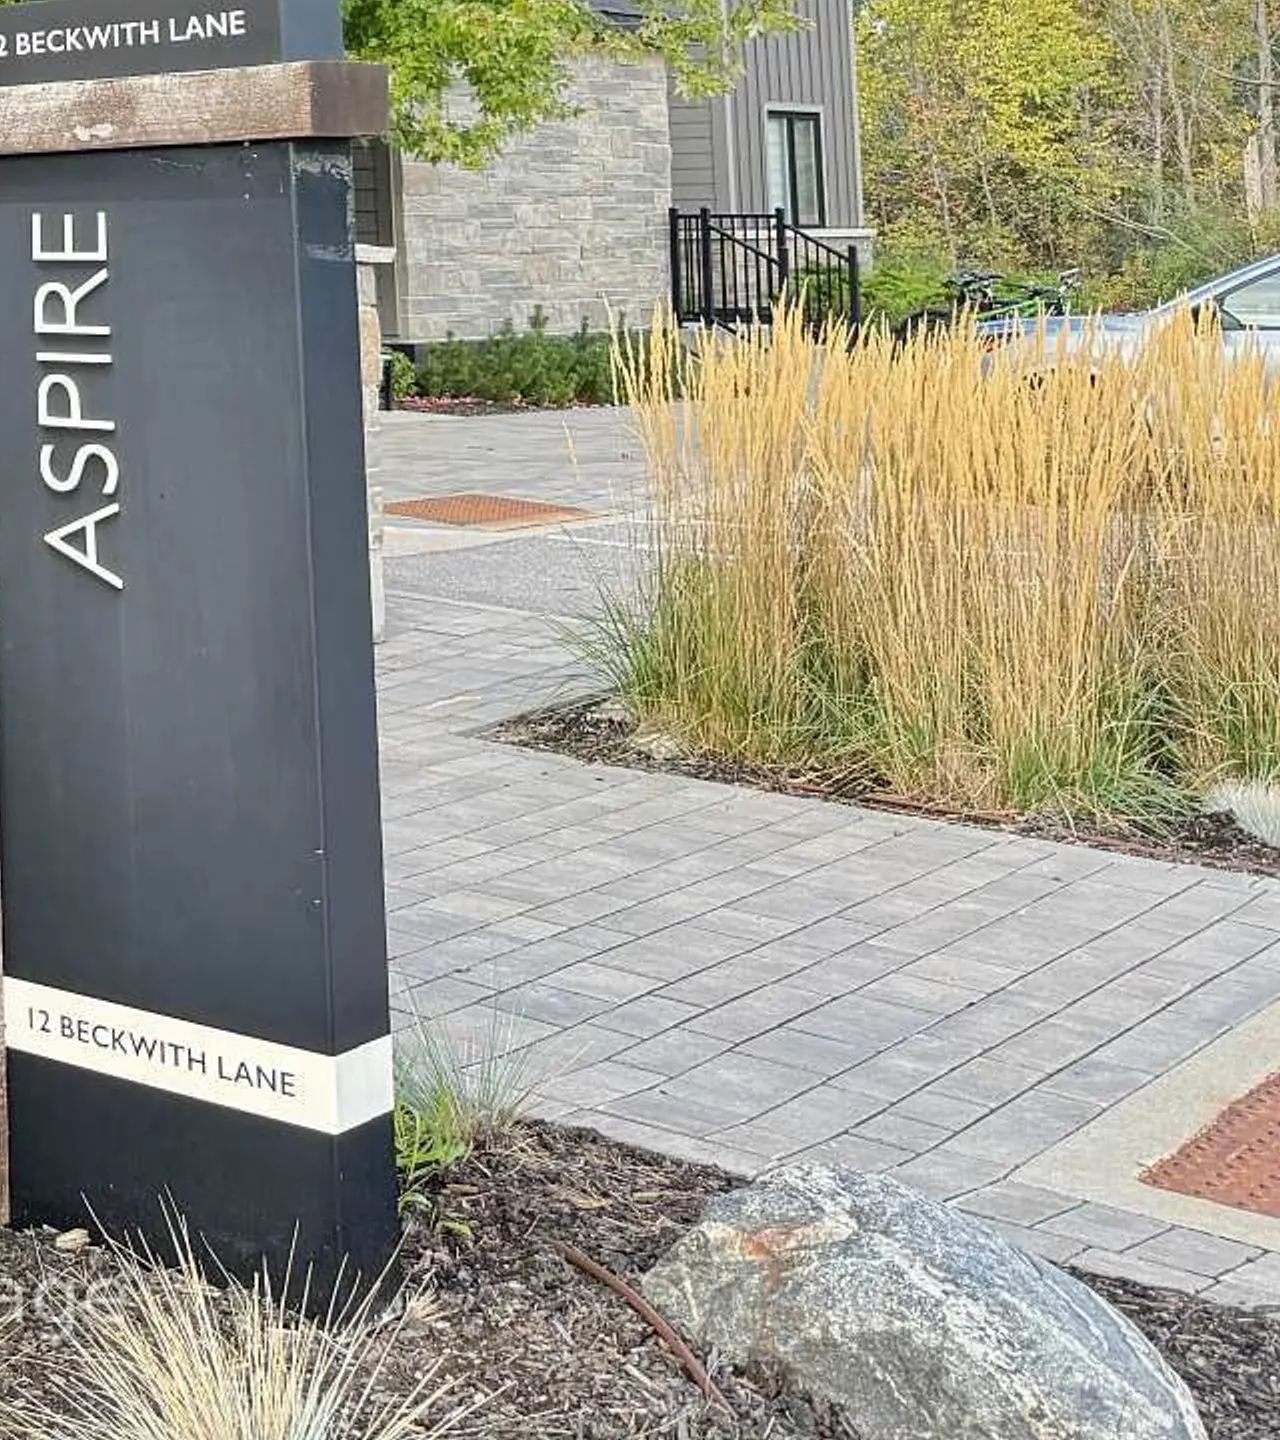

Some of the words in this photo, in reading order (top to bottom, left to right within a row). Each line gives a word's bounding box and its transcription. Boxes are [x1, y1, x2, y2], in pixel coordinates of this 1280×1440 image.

[16, 20, 160, 56] BECKWITH
[169, 10, 246, 41] LANE
[32, 211, 124, 590] ASPIRE
[28, 1008, 52, 1033] 12
[60, 1016, 207, 1075] BECKWITH
[218, 1056, 296, 1097] LANE
